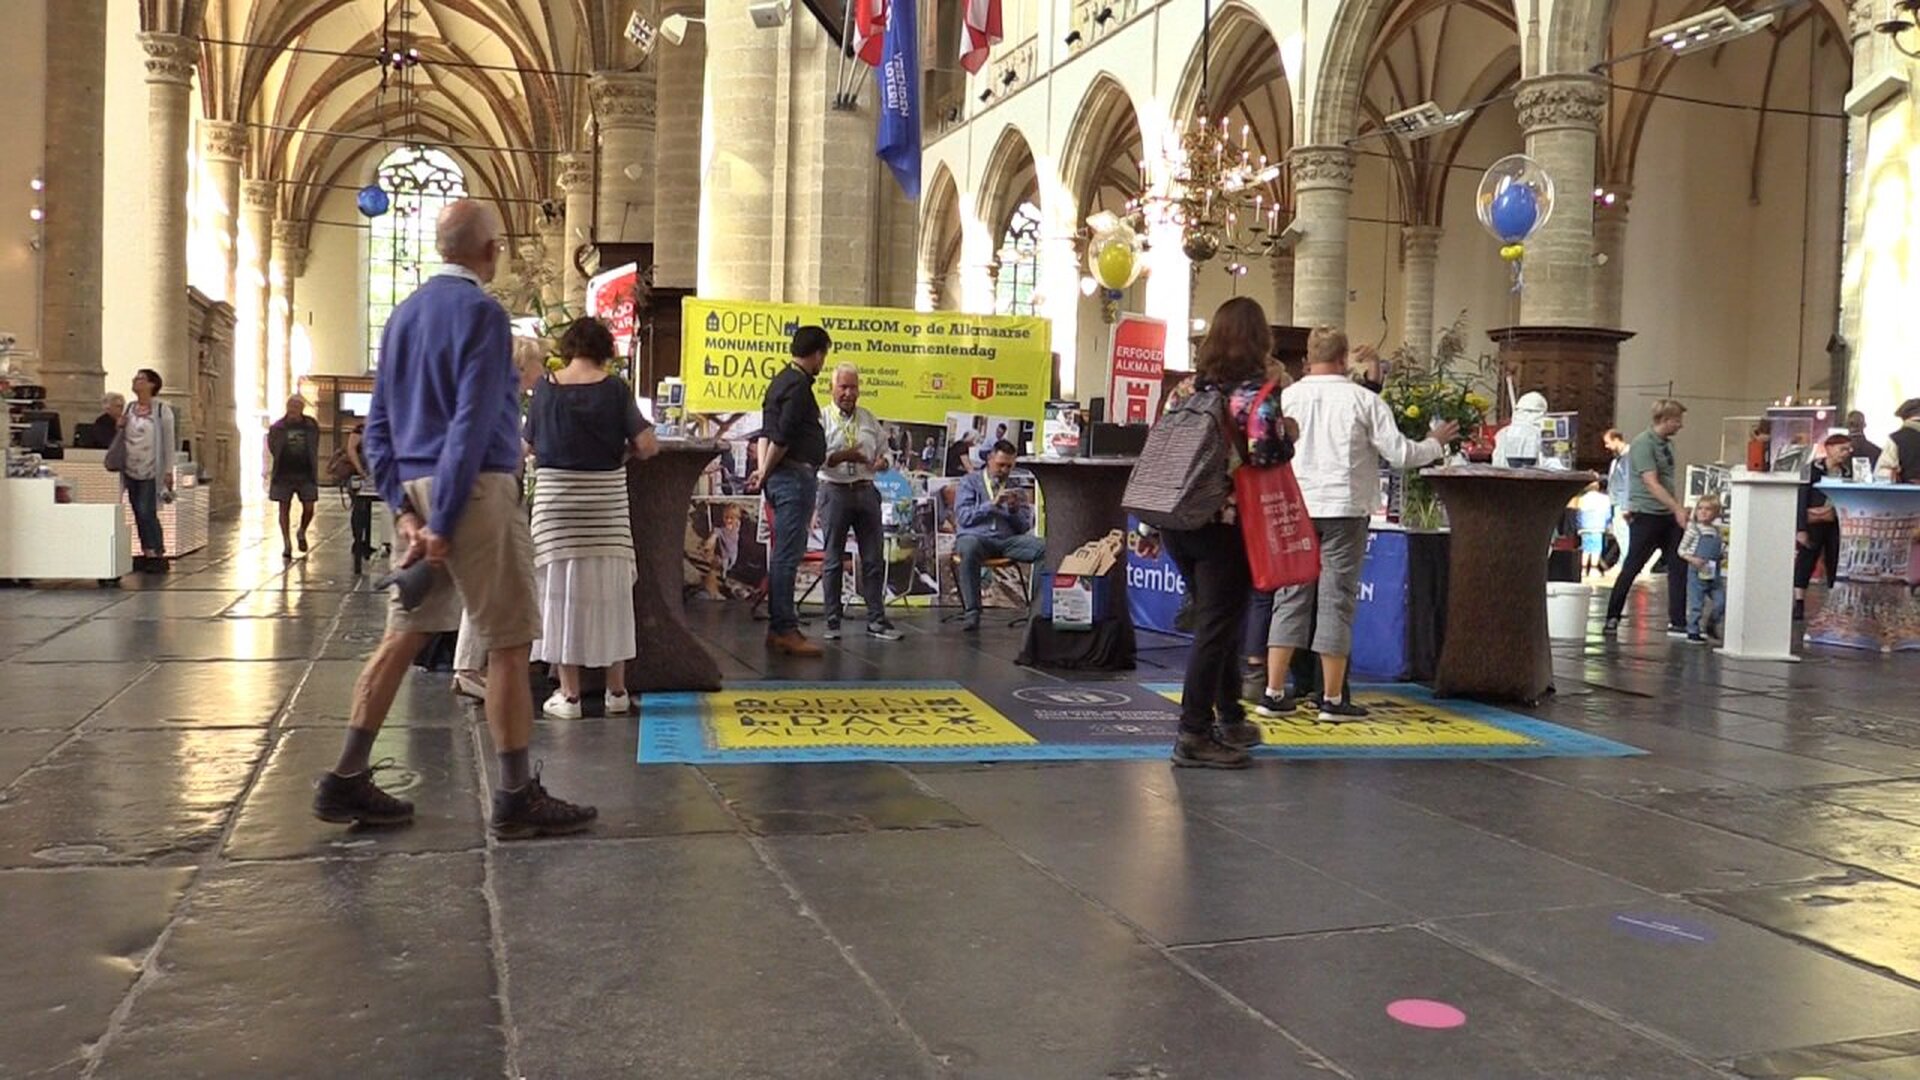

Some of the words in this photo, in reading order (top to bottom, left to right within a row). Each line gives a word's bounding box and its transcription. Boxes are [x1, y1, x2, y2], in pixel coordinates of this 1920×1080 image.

[721, 310, 783, 336] OPEN
[821, 317, 899, 333] WELKOM
[903, 322, 921, 337] op
[926, 323, 944, 335] de
[949, 323, 1030, 339] Alkmaarse
[705, 337, 791, 353] MONUMENTE
[832, 340, 862, 354] pen
[866, 339, 997, 359] Monumentendag
[1116, 345, 1163, 361] ERFGOED
[723, 354, 776, 380] DAG
[1115, 359, 1163, 374] ALKMAAR
[703, 380, 766, 401] ALKMA
[1126, 562, 1186, 595] tembe
[774, 697, 920, 708] OPEN
[789, 714, 930, 727] DAG
[746, 726, 999, 737] ALKMAAR
